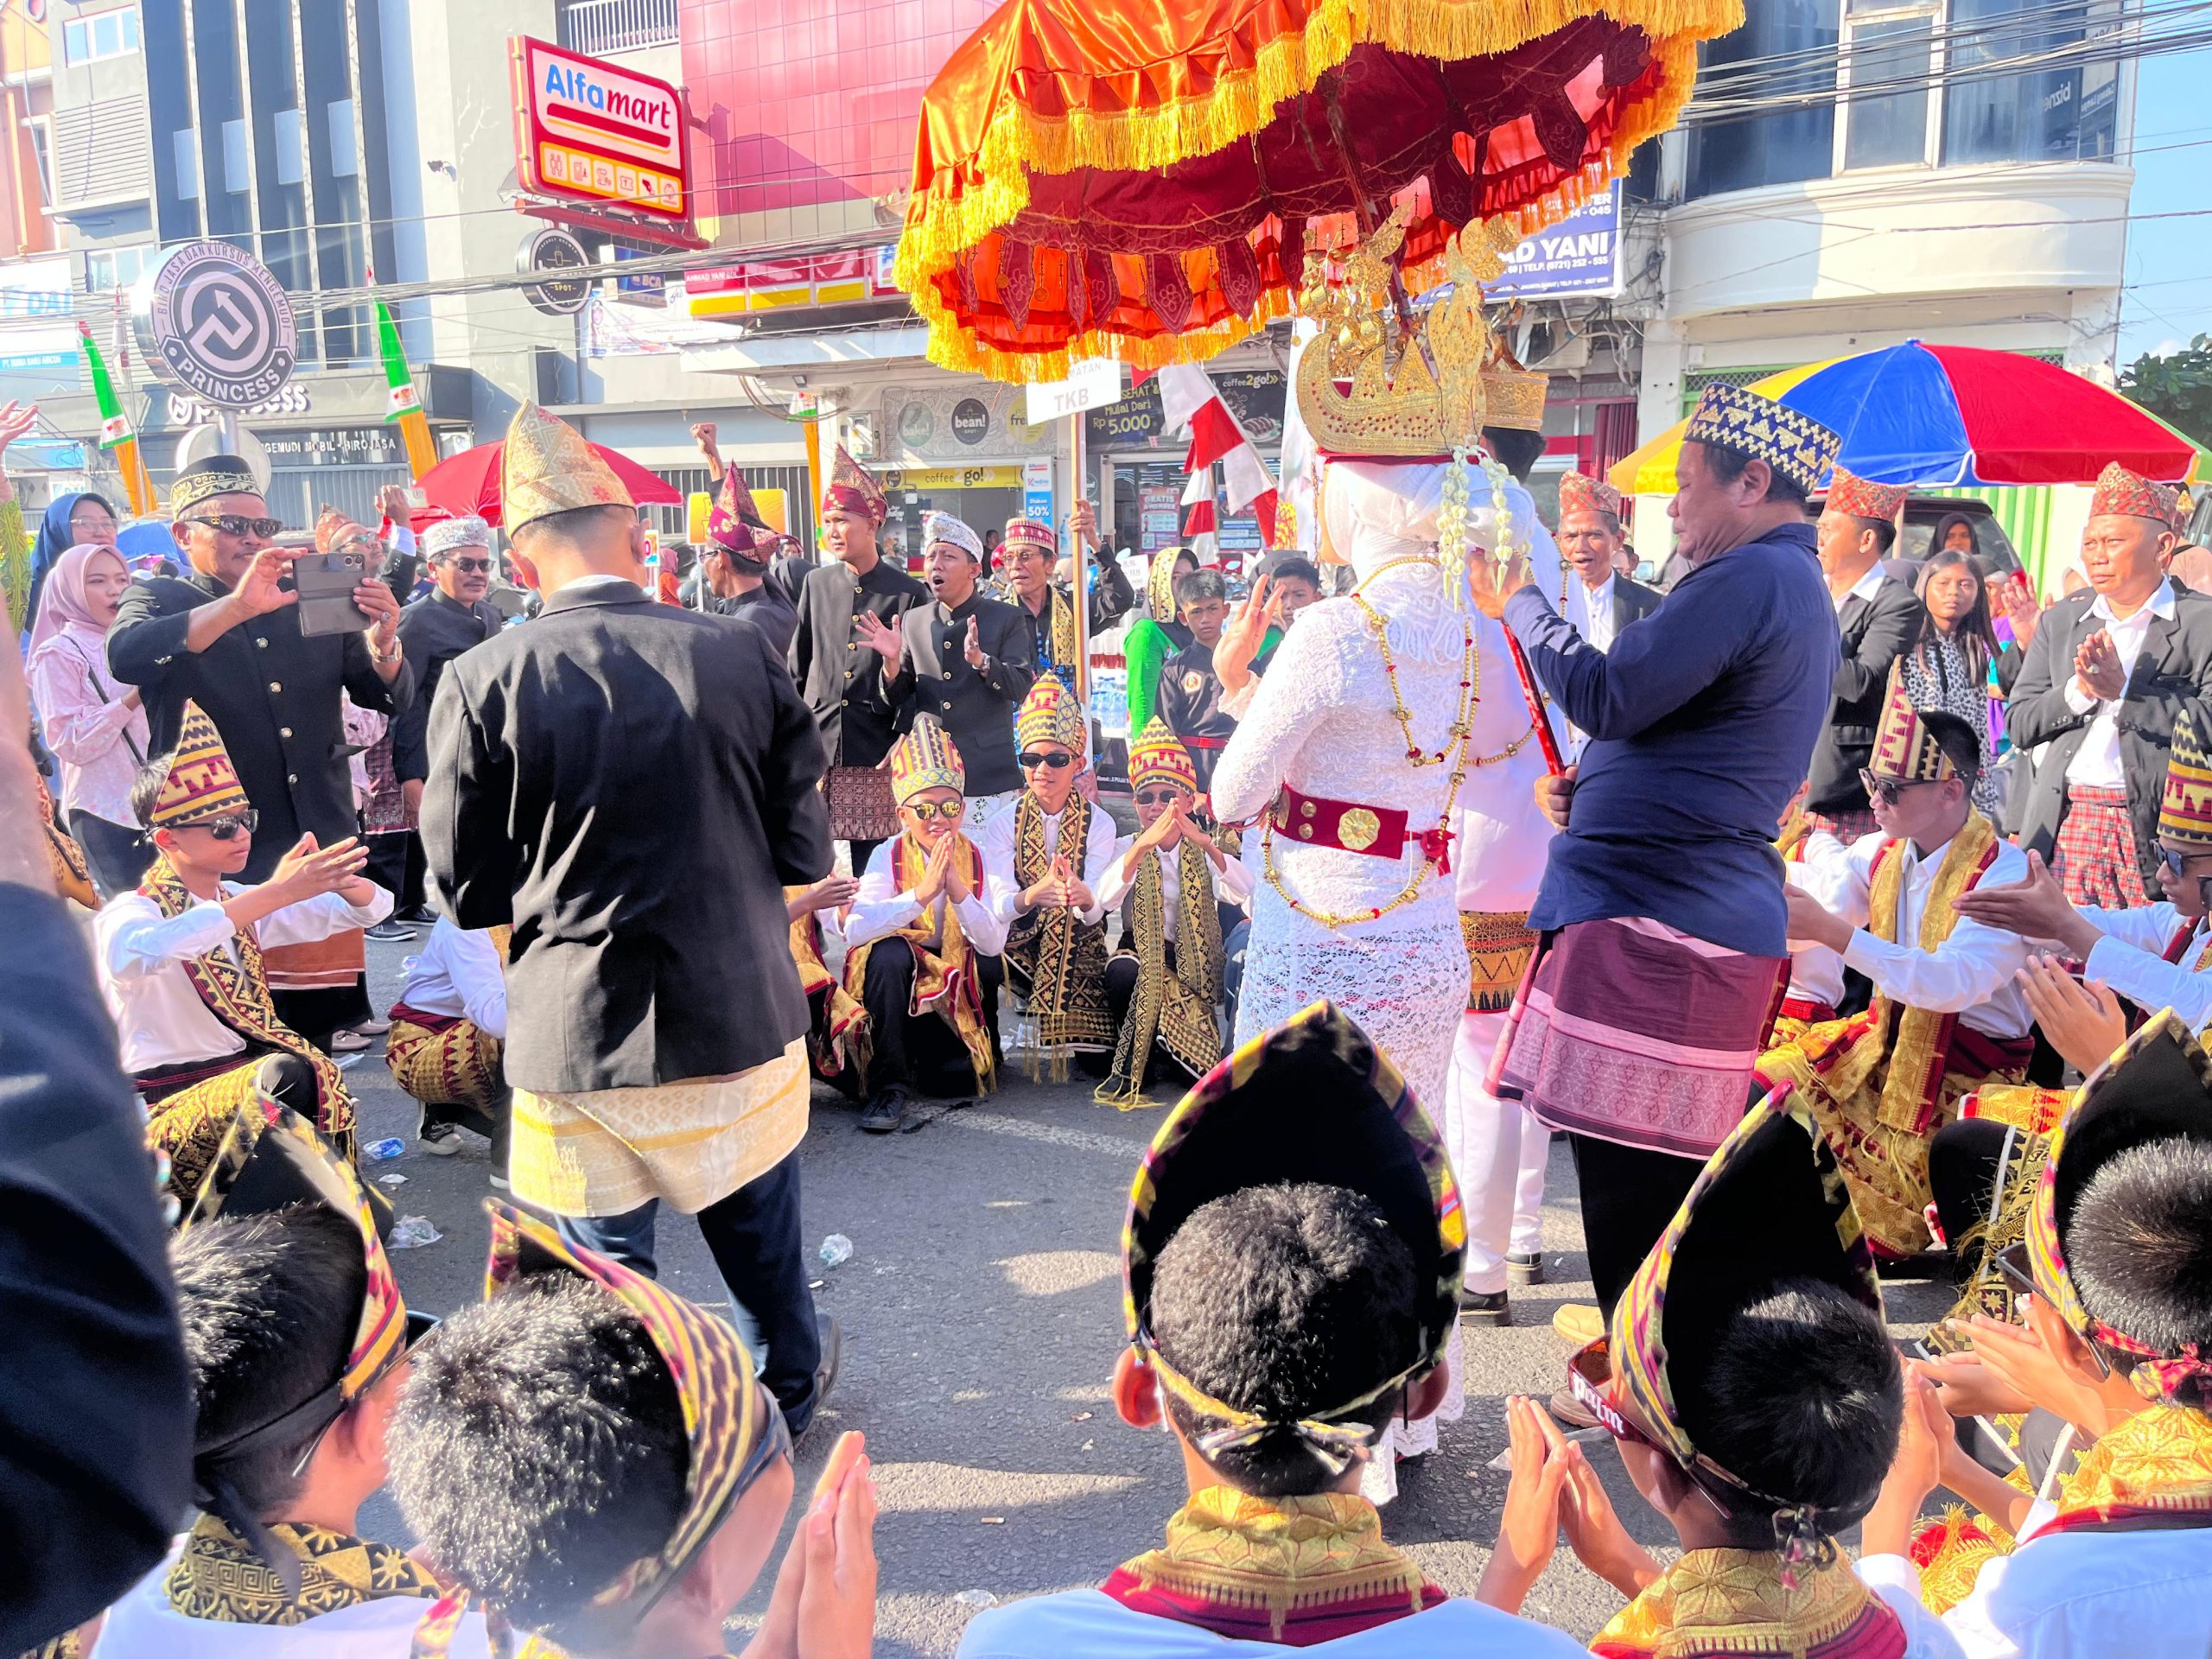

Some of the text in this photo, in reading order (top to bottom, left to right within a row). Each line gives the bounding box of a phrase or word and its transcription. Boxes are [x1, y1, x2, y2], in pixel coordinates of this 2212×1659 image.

[546, 64, 671, 130] Alfamart
[1589, 205, 1611, 217] 045
[1540, 232, 1610, 261] YANI
[168, 256, 187, 285] JASA
[185, 244, 207, 263] DAN
[207, 244, 251, 268] KURSUS
[251, 261, 292, 329] MENGEMUDI
[642, 274, 663, 289] BCA
[177, 357, 282, 402] PRINCESS
[1053, 387, 1090, 413] TKB
[1104, 400, 1152, 416] Mulai Dari
[955, 415, 987, 429] bean!
[1092, 414, 1151, 435] Rp 5.000
[305, 438, 336, 454] MOBIL
[1027, 505, 1050, 517] 50%
